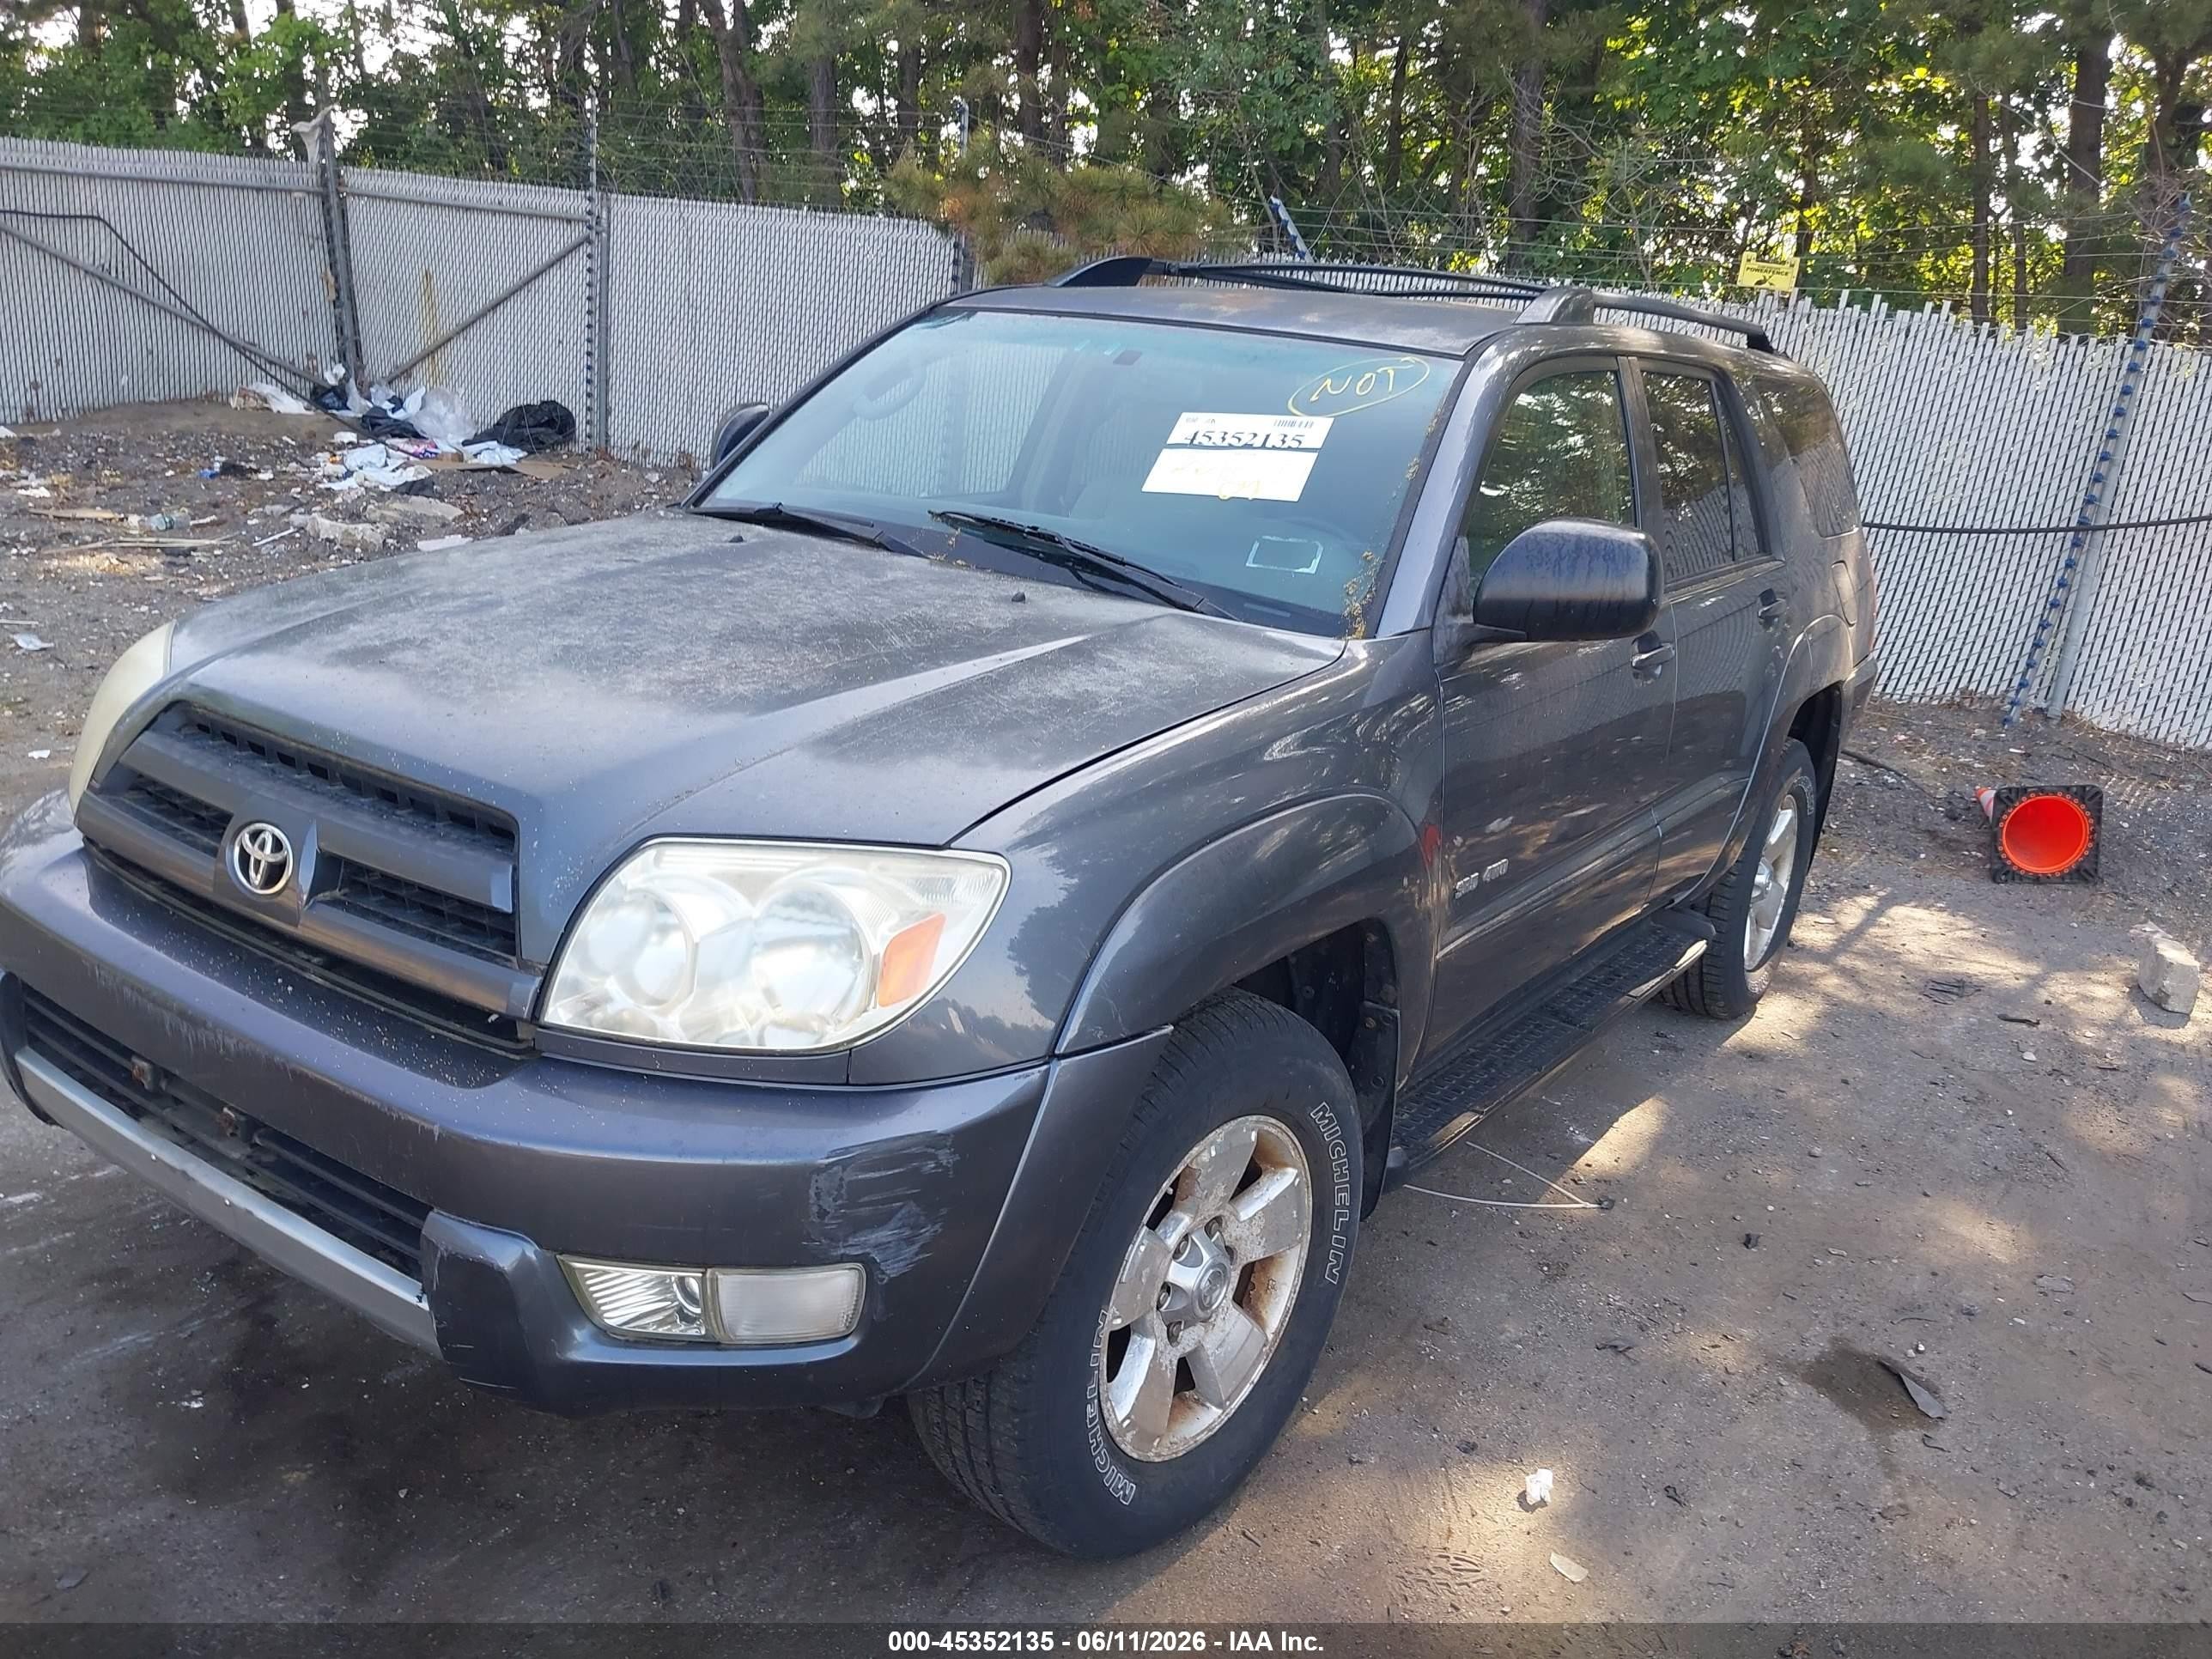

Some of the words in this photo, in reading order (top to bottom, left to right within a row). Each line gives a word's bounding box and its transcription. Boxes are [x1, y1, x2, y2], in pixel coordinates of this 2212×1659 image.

[1746, 267, 1789, 276] POWERFENCE
[1310, 363, 1415, 403] NOT
[1184, 429, 1306, 448] 45352135
[1310, 1101, 1351, 1285] MICHELIN
[1086, 1309, 1137, 1505] MICHELIN
